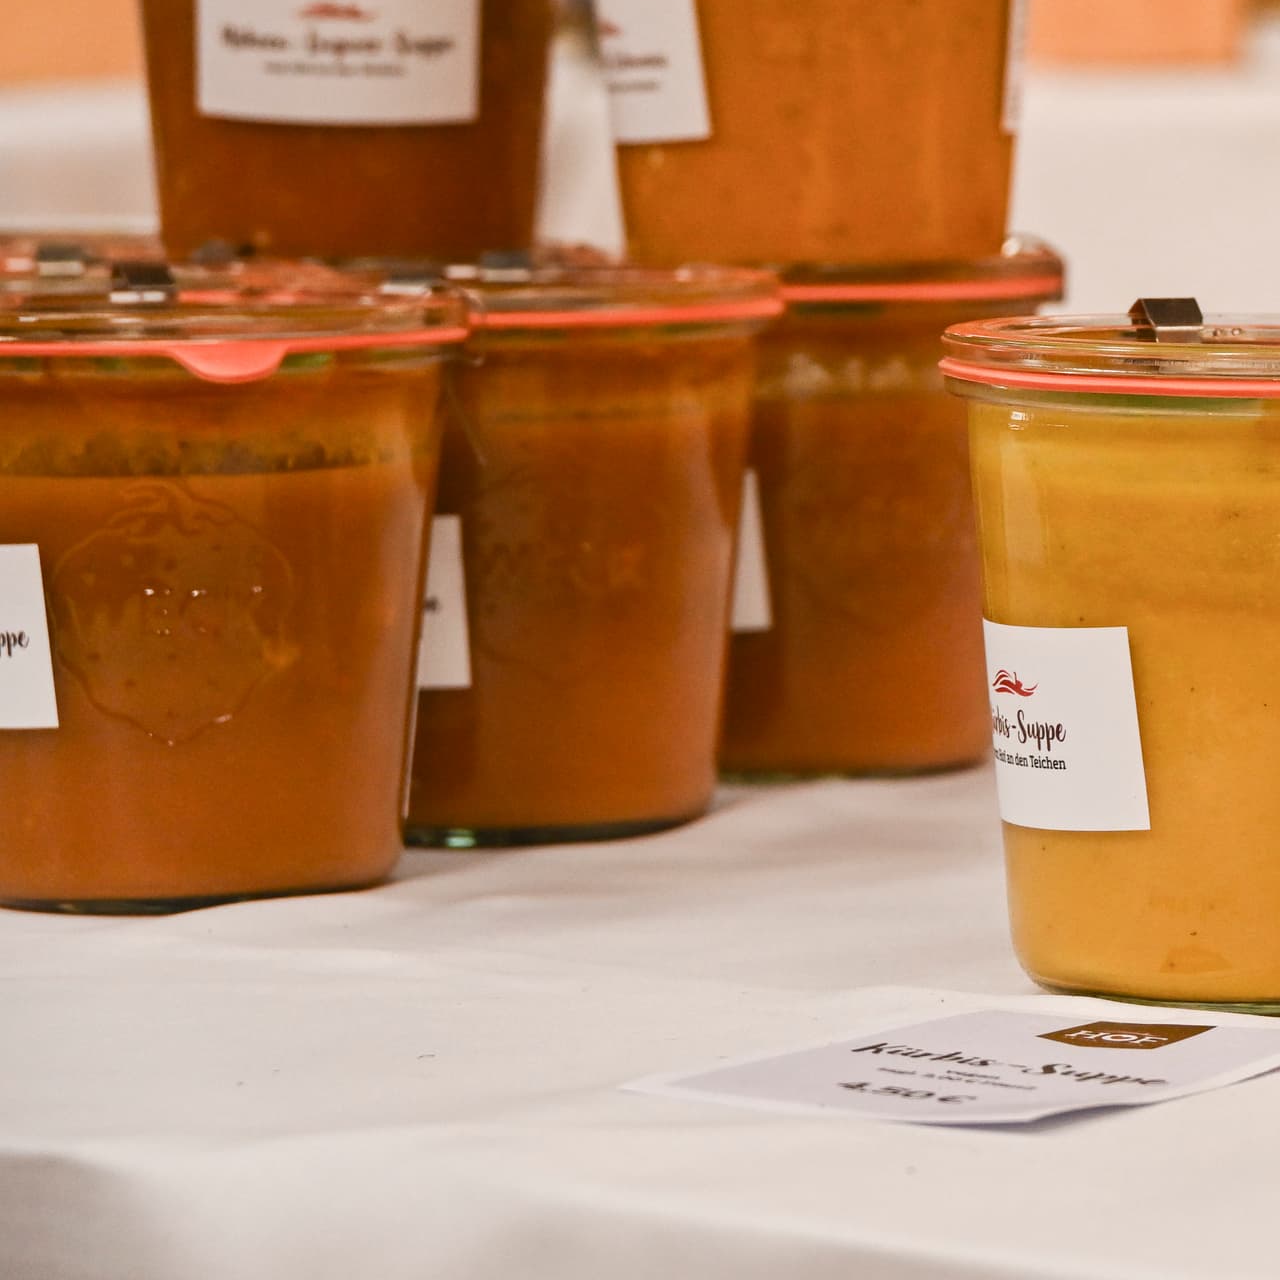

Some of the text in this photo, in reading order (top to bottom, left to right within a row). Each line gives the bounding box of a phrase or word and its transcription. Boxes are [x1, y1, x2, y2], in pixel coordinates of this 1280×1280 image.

[0, 631, 29, 658] ppe
[1015, 752, 1028, 767] den
[1029, 755, 1067, 770] Teichen
[1064, 1029, 1169, 1045] HOF
[851, 1042, 1169, 1086] Kürbis-Suppe
